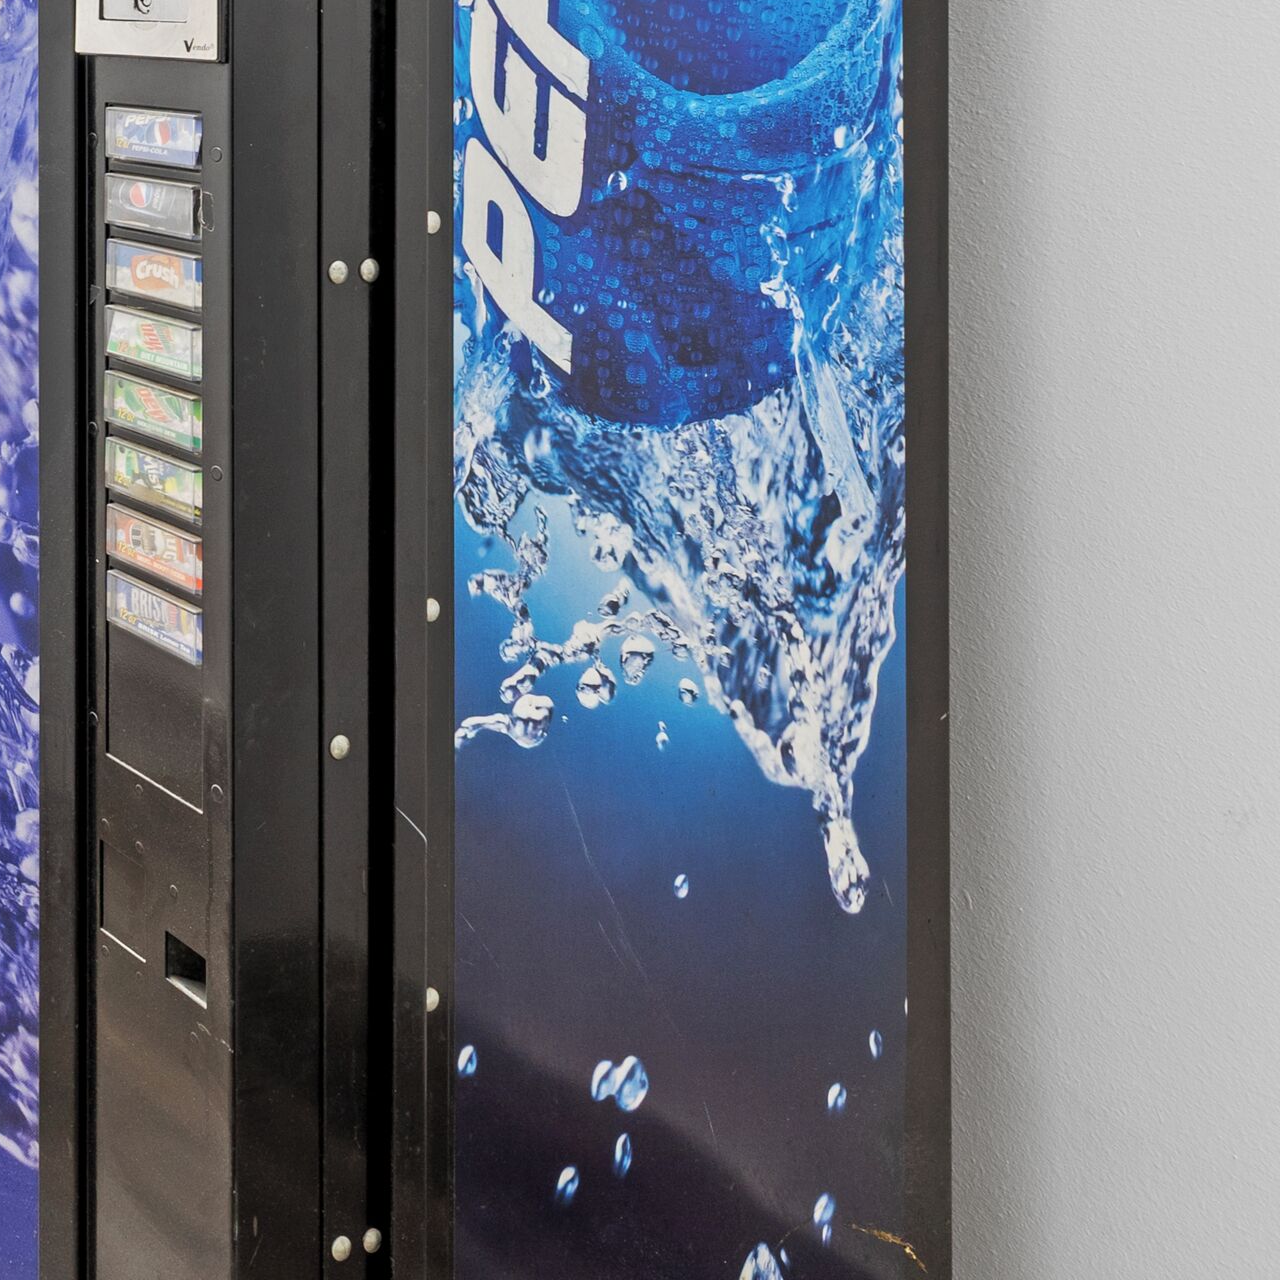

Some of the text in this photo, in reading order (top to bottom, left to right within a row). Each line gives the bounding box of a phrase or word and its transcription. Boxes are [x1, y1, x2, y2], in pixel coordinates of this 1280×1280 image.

[132, 144, 168, 155] PEPSI-COLA
[136, 260, 180, 289] Crush
[118, 407, 126, 419] 12
[118, 541, 127, 553] 12
[120, 606, 128, 620] 12
[137, 621, 159, 638] BRISK
